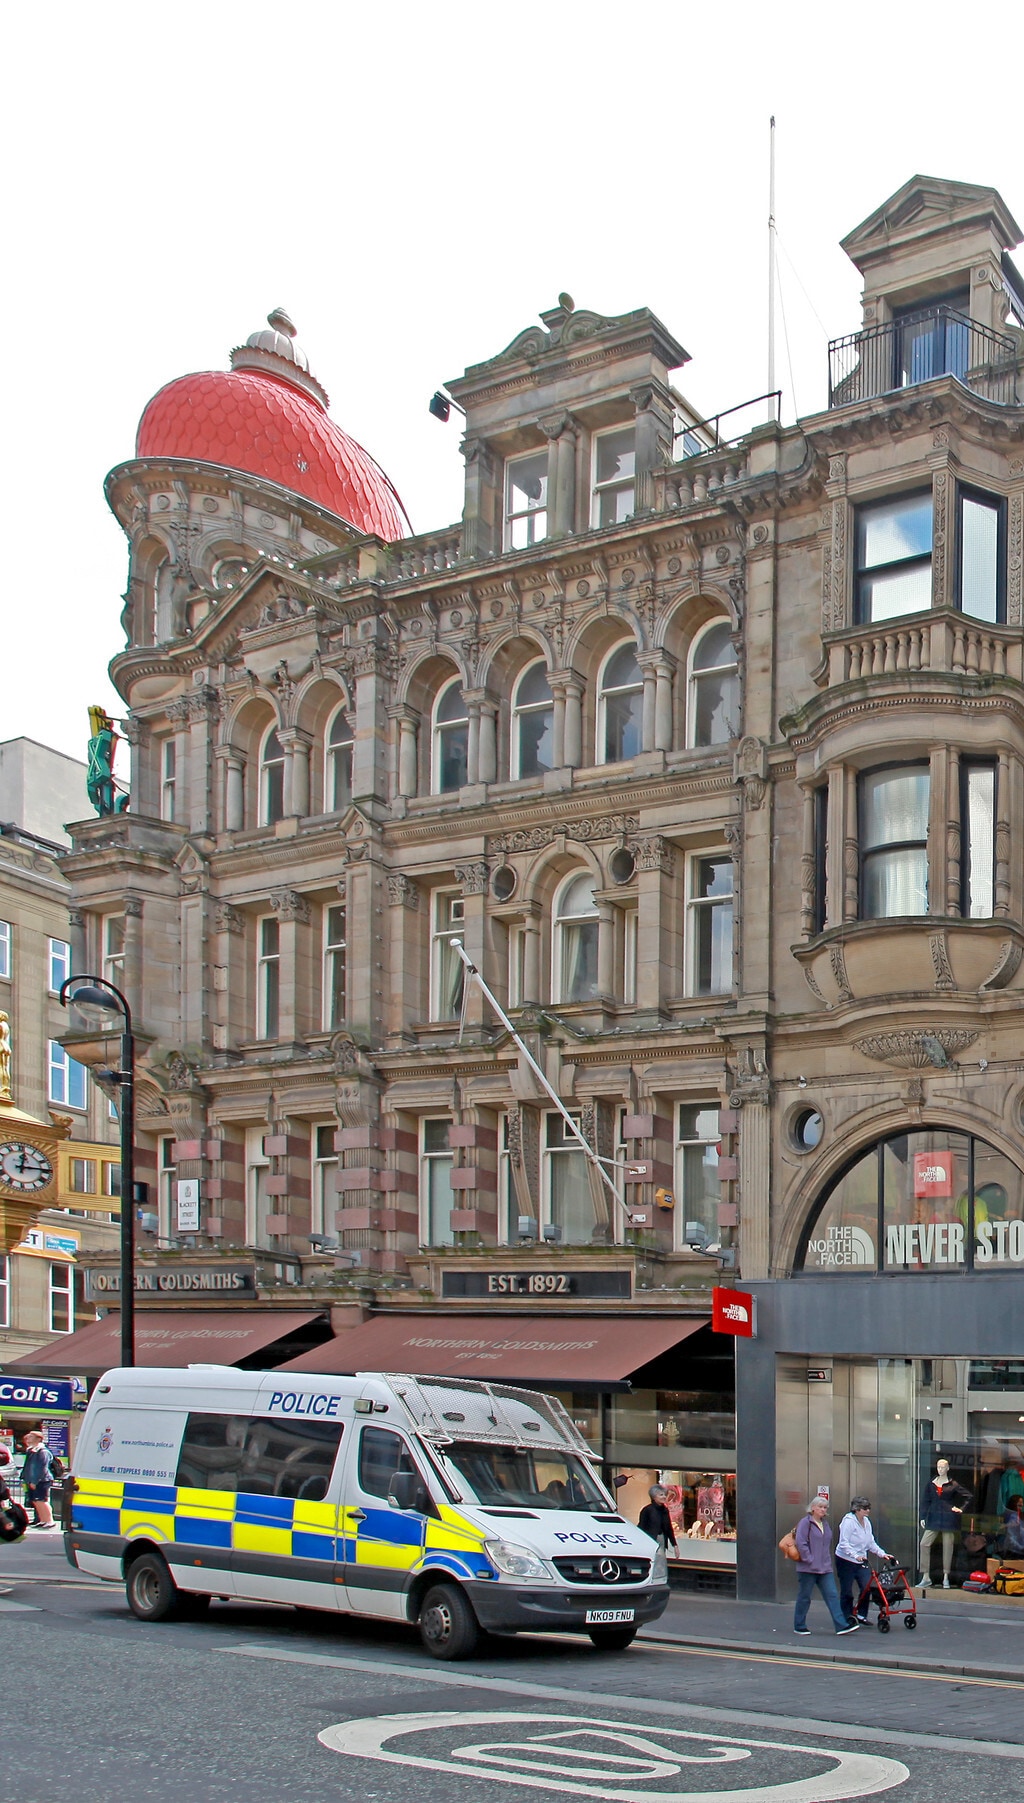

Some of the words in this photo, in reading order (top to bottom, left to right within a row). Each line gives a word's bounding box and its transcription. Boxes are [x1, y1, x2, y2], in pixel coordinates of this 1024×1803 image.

[828, 1226, 851, 1239] THE
[808, 1240, 851, 1252] NORTH
[887, 1223, 965, 1265] NEVER
[820, 1253, 851, 1265] FACE
[91, 1274, 152, 1290] NORTRN
[158, 1272, 240, 1291] GOLDSMITHS
[488, 1275, 524, 1293] EST.
[528, 1274, 567, 1293] 1892
[722, 1307, 740, 1316] NORTH
[729, 1303, 740, 1311] THE
[726, 1313, 740, 1321] FACE
[172, 1329, 254, 1339] GOLDSMITHS
[402, 1337, 491, 1349] NORTHERN
[493, 1339, 598, 1351] GOLDSMITHS
[268, 1391, 342, 1416] POLICE
[101, 1466, 116, 1474] CRIME
[117, 1467, 141, 1475] STOPPERS
[142, 1469, 156, 1477] 0800
[157, 1470, 167, 1478] 555
[699, 1508, 721, 1517] LOVE
[553, 1532, 633, 1546] POLICE
[590, 1611, 614, 1621] NK09
[615, 1610, 631, 1621] FNU
